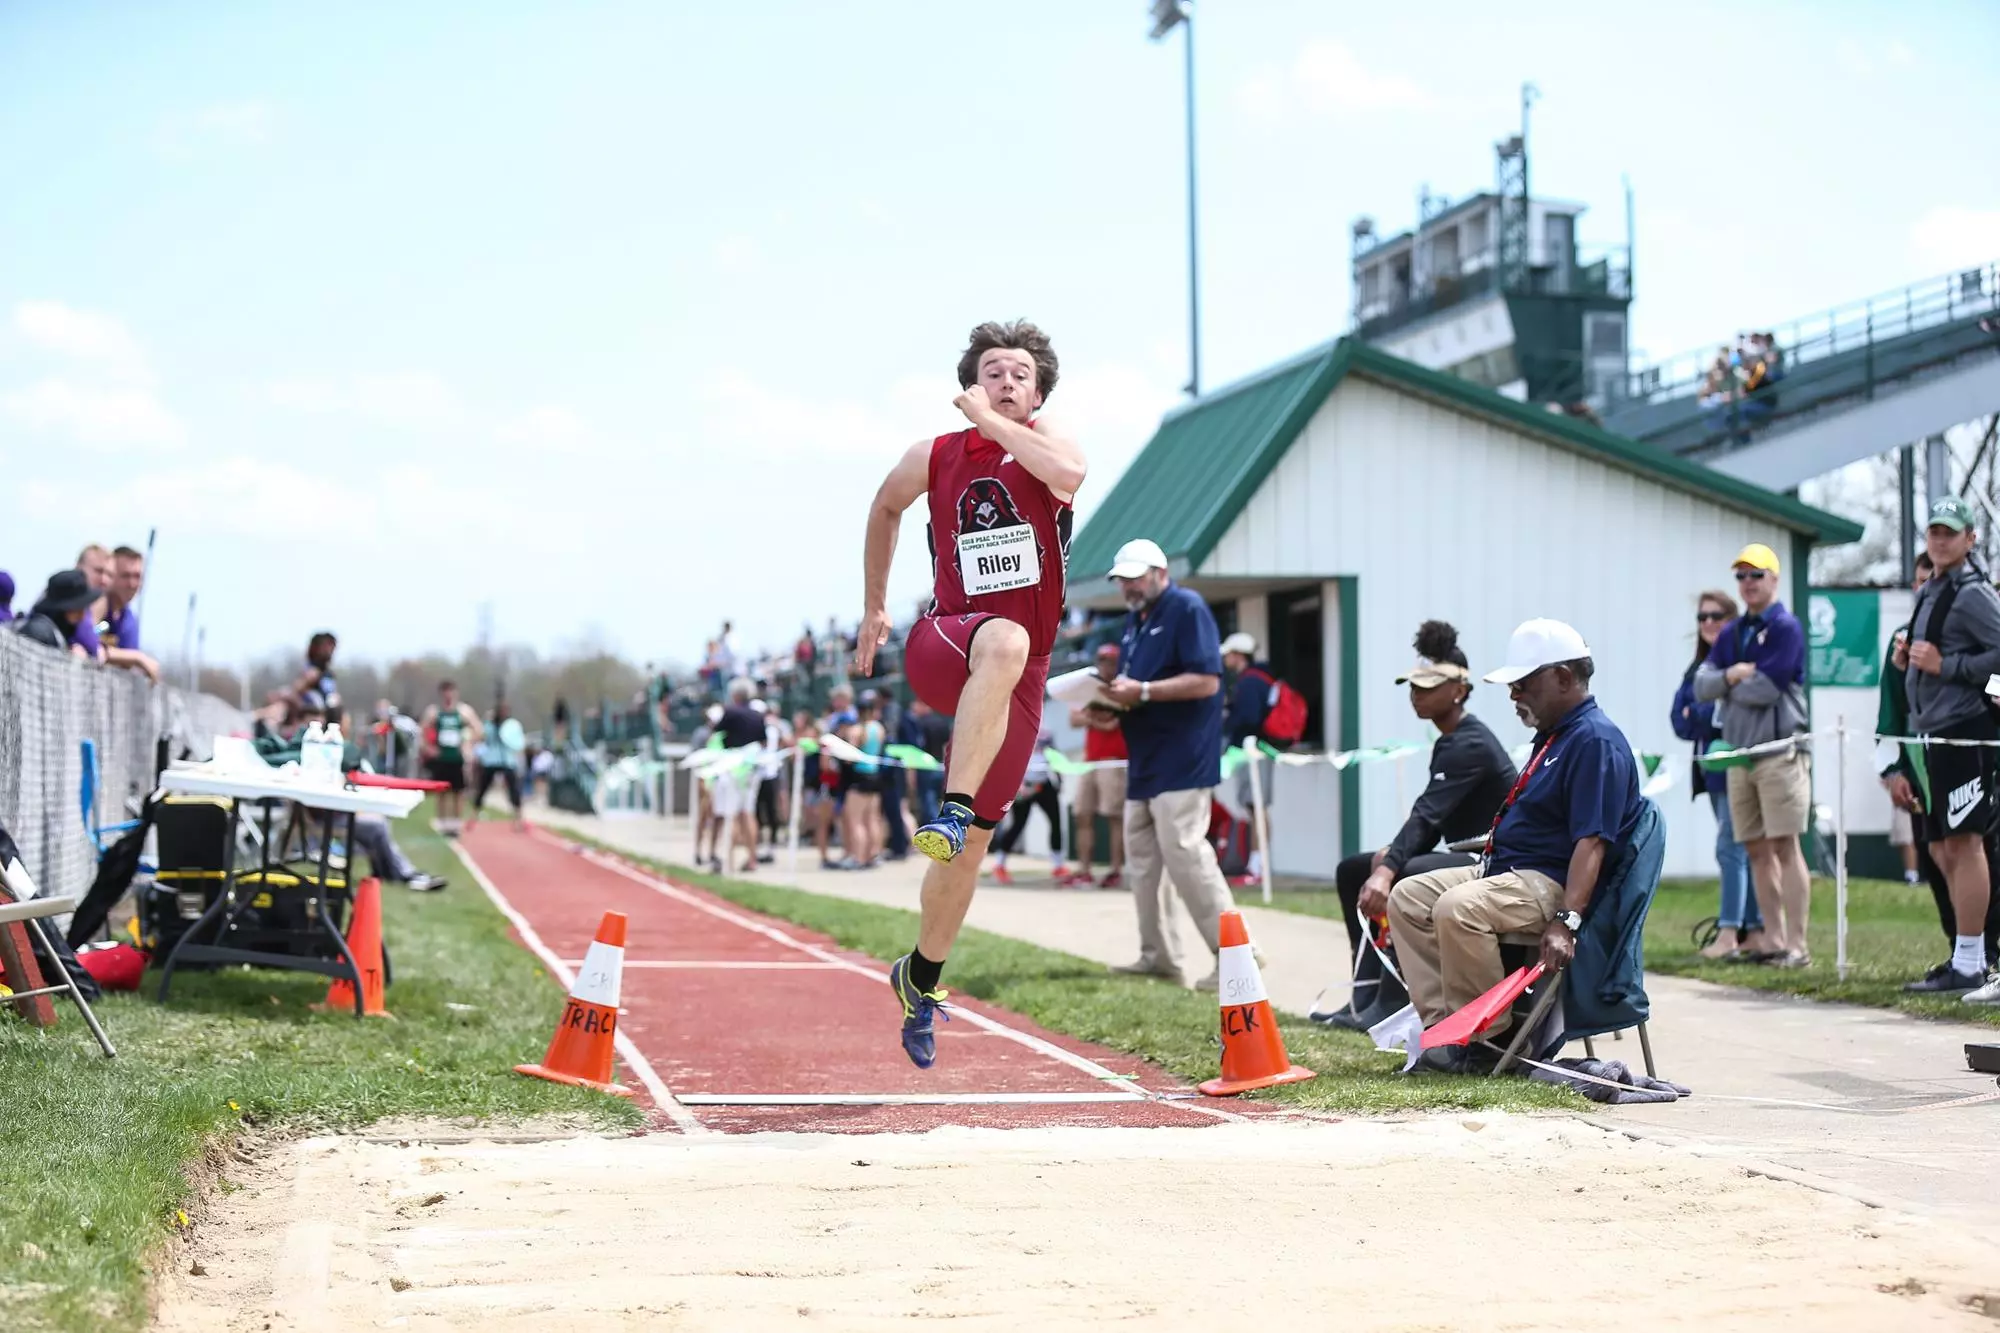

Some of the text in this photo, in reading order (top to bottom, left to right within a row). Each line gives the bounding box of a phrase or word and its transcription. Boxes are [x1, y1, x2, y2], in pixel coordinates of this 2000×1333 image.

[962, 535, 1031, 551] SLIPPERY ROCK UNIVERSITY
[975, 535, 991, 543] PSAC
[991, 533, 1008, 541] Track
[977, 554, 1021, 576] Riley
[976, 584, 992, 592] PSAC
[1000, 580, 1013, 588] THE
[1014, 577, 1030, 585] ROCK
[1948, 775, 1982, 812] NIKE
